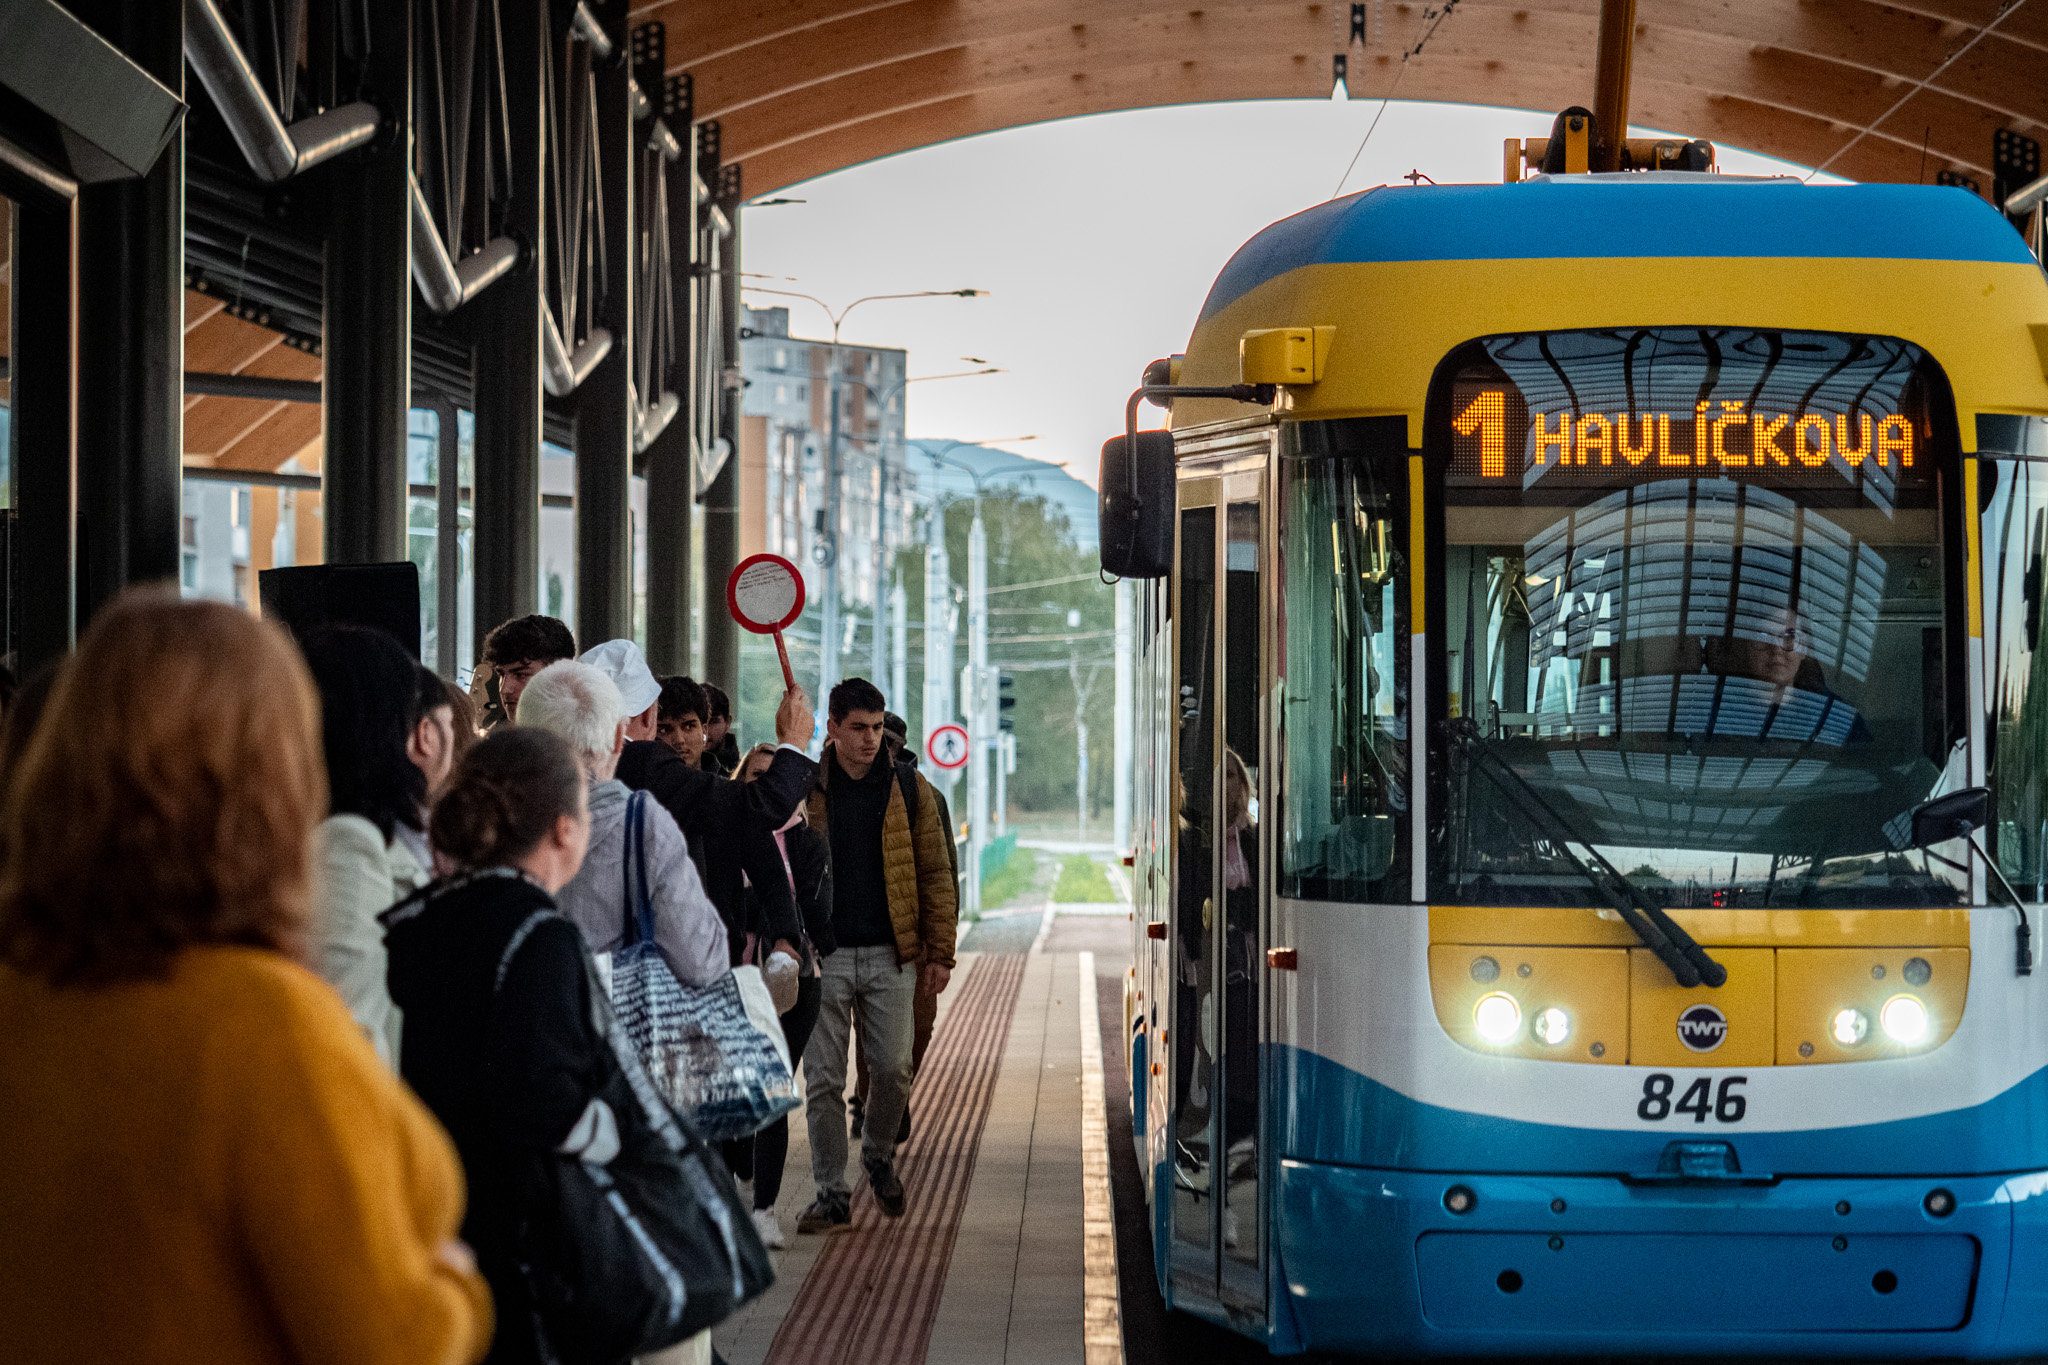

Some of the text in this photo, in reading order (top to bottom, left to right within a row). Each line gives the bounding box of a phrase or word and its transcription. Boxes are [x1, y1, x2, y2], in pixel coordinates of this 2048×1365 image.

[1452, 391, 1914, 477] 1 HAVLÍČKOVA
[1637, 1073, 1748, 1124] 846
